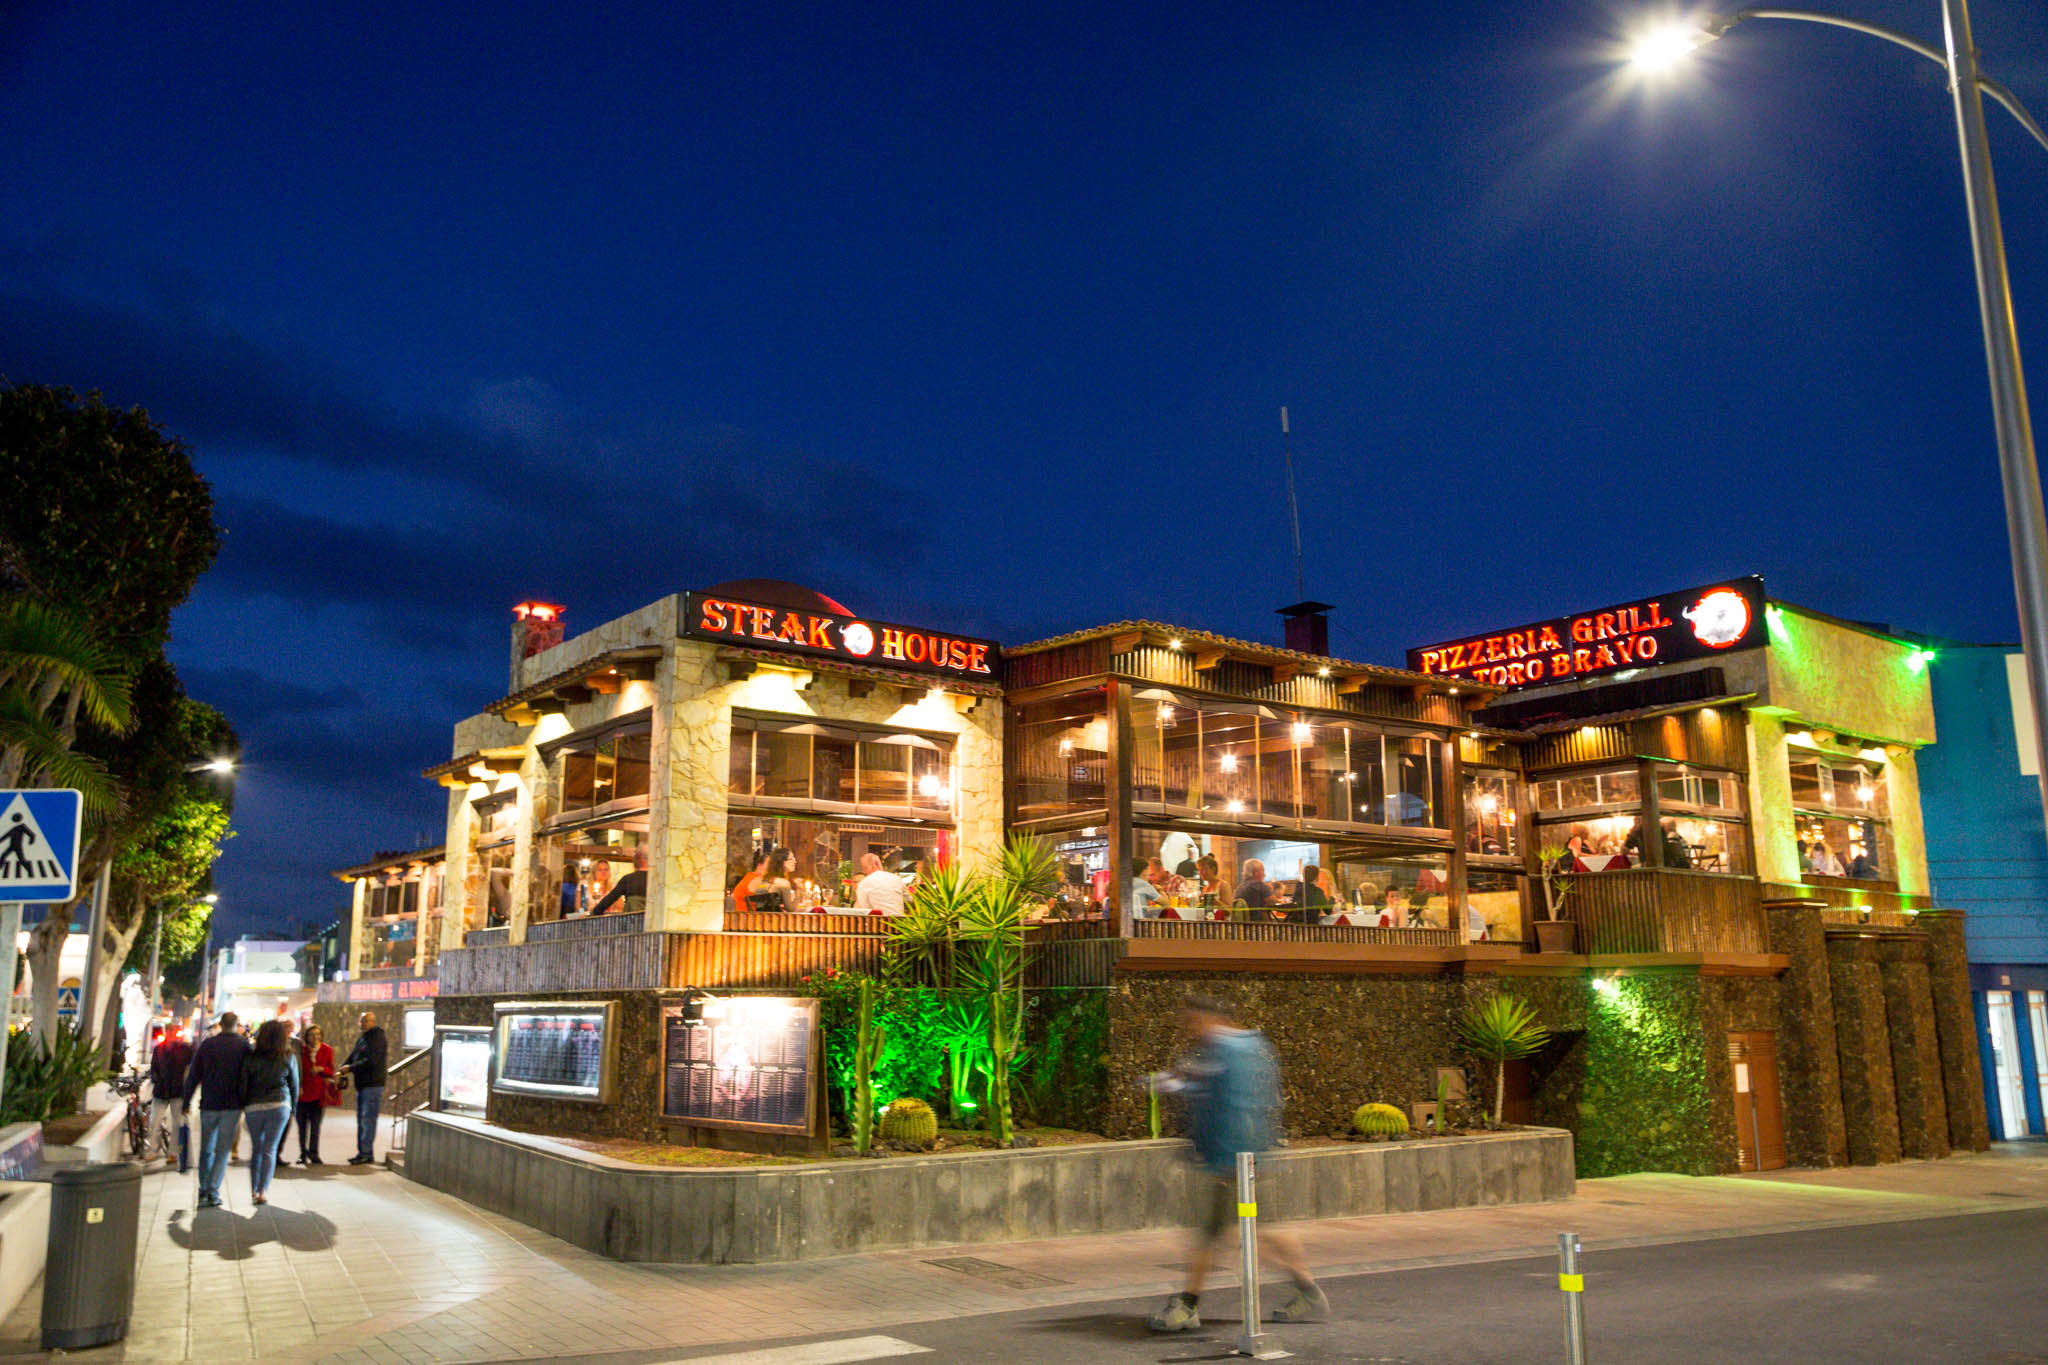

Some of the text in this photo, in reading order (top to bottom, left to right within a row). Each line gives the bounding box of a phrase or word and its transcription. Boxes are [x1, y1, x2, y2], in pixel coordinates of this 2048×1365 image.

[700, 599, 991, 674] STEAK HOUSE
[1421, 602, 1673, 675] PIZZERIA GRILL
[1552, 635, 1658, 677] BRAVO
